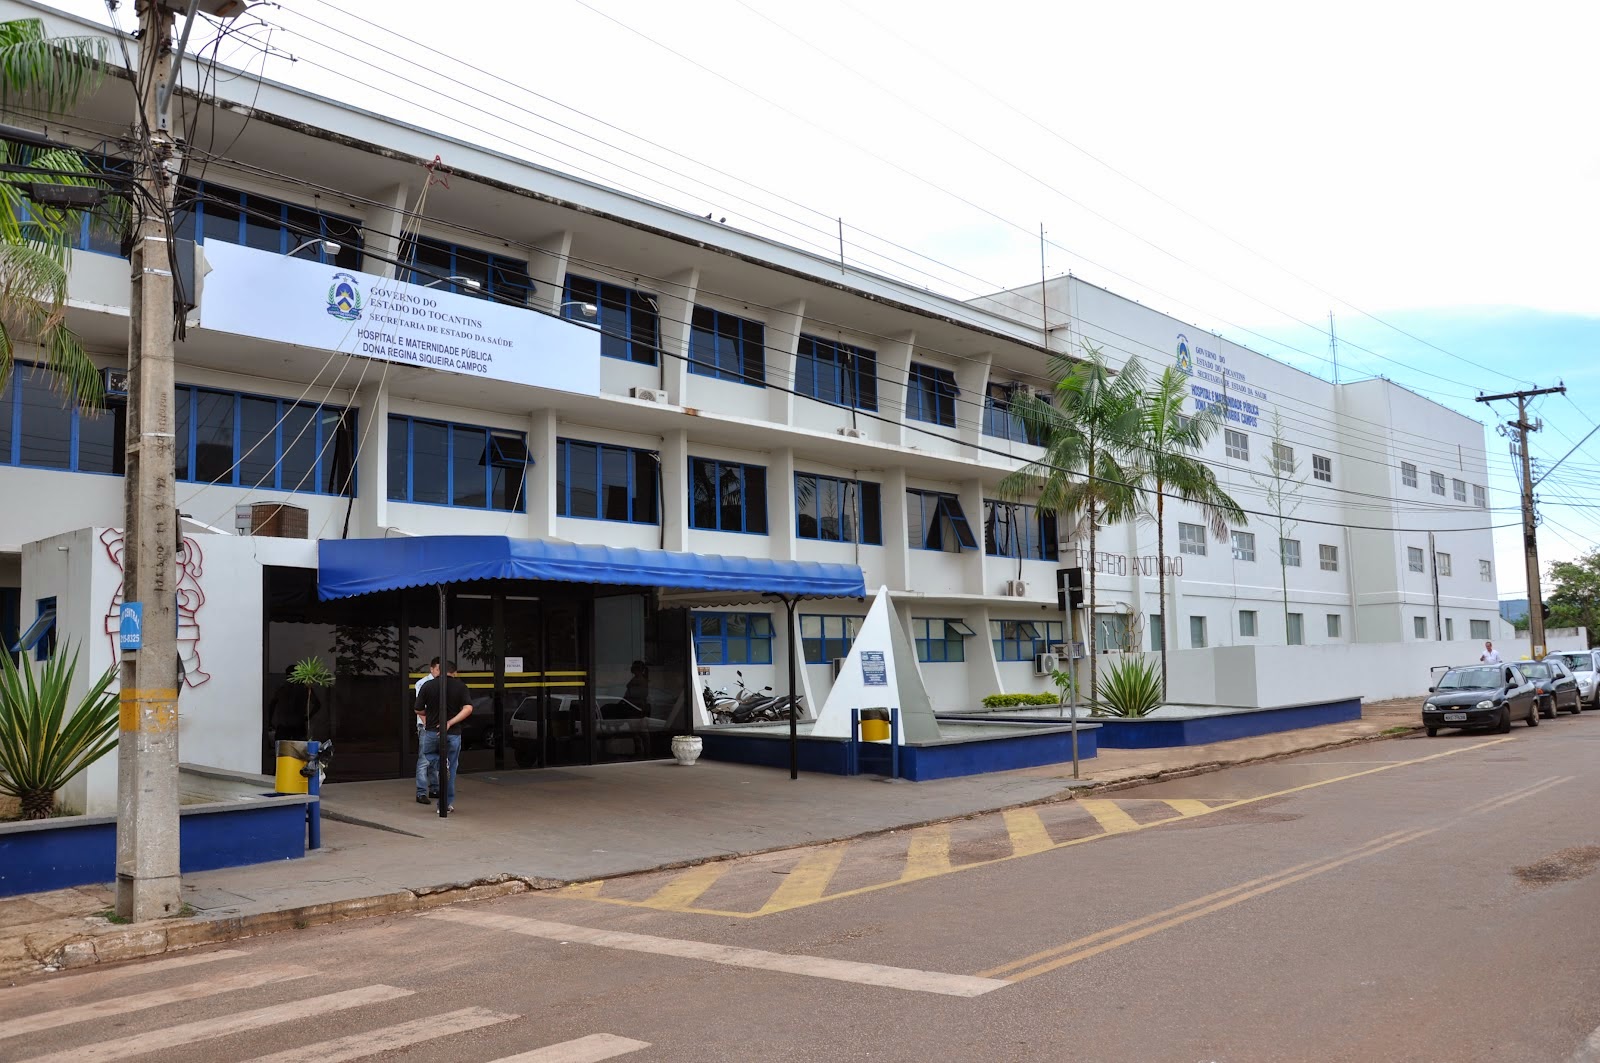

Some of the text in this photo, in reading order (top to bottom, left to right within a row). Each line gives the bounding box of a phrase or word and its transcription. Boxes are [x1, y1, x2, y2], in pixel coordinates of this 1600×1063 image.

[370, 286, 437, 308] GOVERNO DO
[370, 298, 483, 329] ESTADO DO TOCANTINS
[369, 313, 425, 331] SECRETARIA
[427, 324, 439, 334] DE
[440, 327, 473, 340] ESTADO
[474, 333, 486, 343] DA
[487, 336, 514, 348] SAÚDE
[357, 328, 493, 362] HOSPITAL E MATERNIDADE PÚBLICA
[1196, 346, 1216, 360] GOVERNO
[362, 342, 488, 374] DONA REGINA SIQUEIRA CAMPOS
[1196, 356, 1214, 369] ESTADO
[1214, 364, 1222, 372] DO
[1192, 384, 1212, 400] HOSPITAL
[1232, 382, 1246, 392] ESTADO
[1132, 555, 1152, 577] ANO
